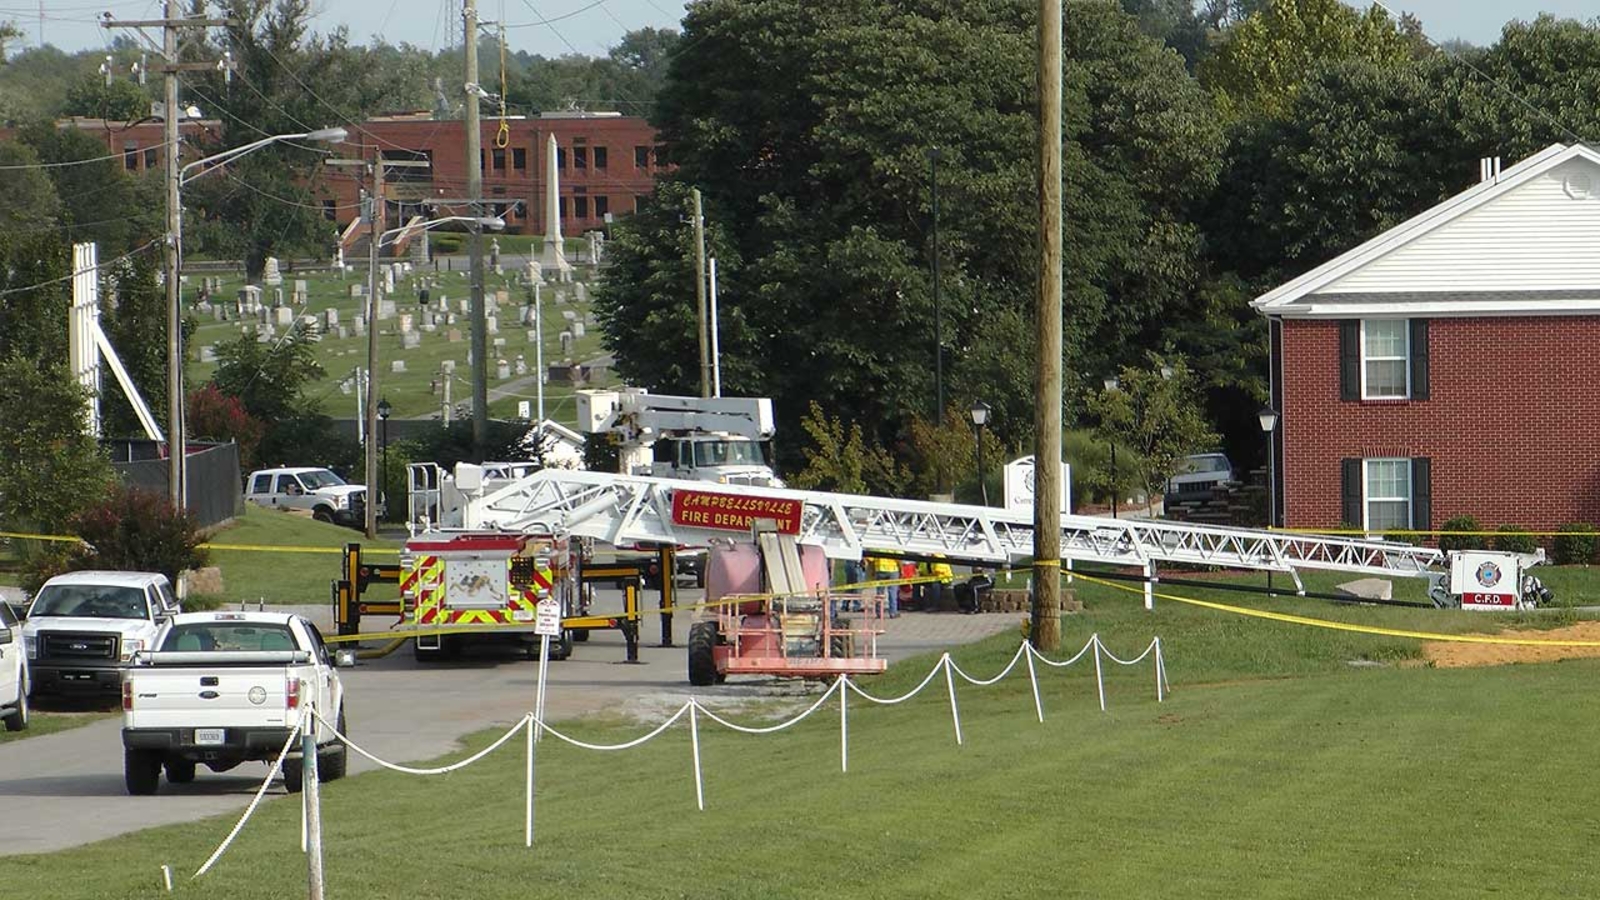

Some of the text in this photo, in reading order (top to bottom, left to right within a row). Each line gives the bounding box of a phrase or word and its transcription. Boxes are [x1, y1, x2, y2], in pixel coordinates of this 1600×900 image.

[683, 494, 792, 514] CAMPBELLSVILLE
[682, 510, 792, 530] FIRE DEPARNT
[1475, 594, 1502, 604] C.F.D.
